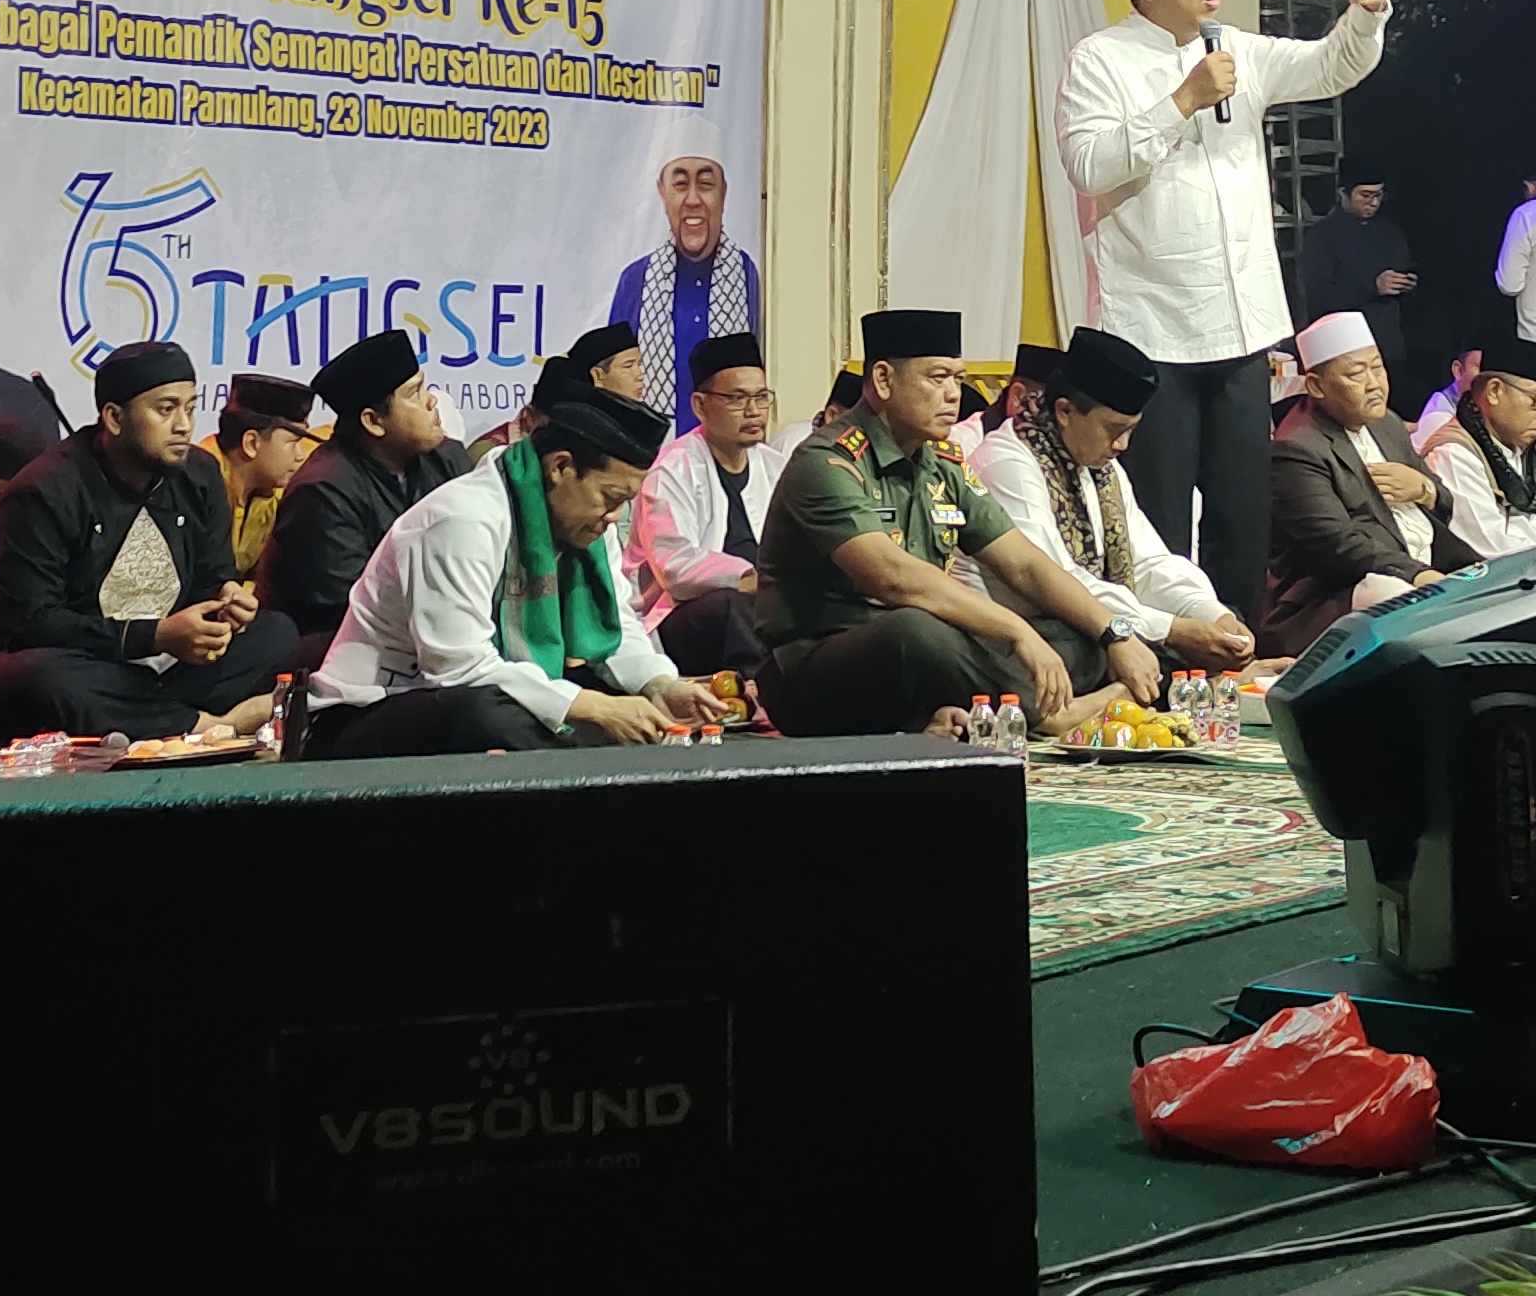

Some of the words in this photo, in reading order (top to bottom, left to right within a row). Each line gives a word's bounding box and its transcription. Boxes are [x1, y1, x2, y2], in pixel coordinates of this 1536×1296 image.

[96, 6, 250, 68] Pemantik
[250, 26, 398, 83] Semangat
[402, 35, 541, 94] Persatuan
[544, 49, 592, 99] dan
[19, 67, 177, 124] Kecamatan
[181, 82, 323, 138] Pamulang,
[326, 95, 362, 136] 23
[365, 95, 486, 145] November
[490, 105, 550, 149] 2023
[160, 233, 192, 260] TH
[319, 1082, 693, 1156] V8SOUND
